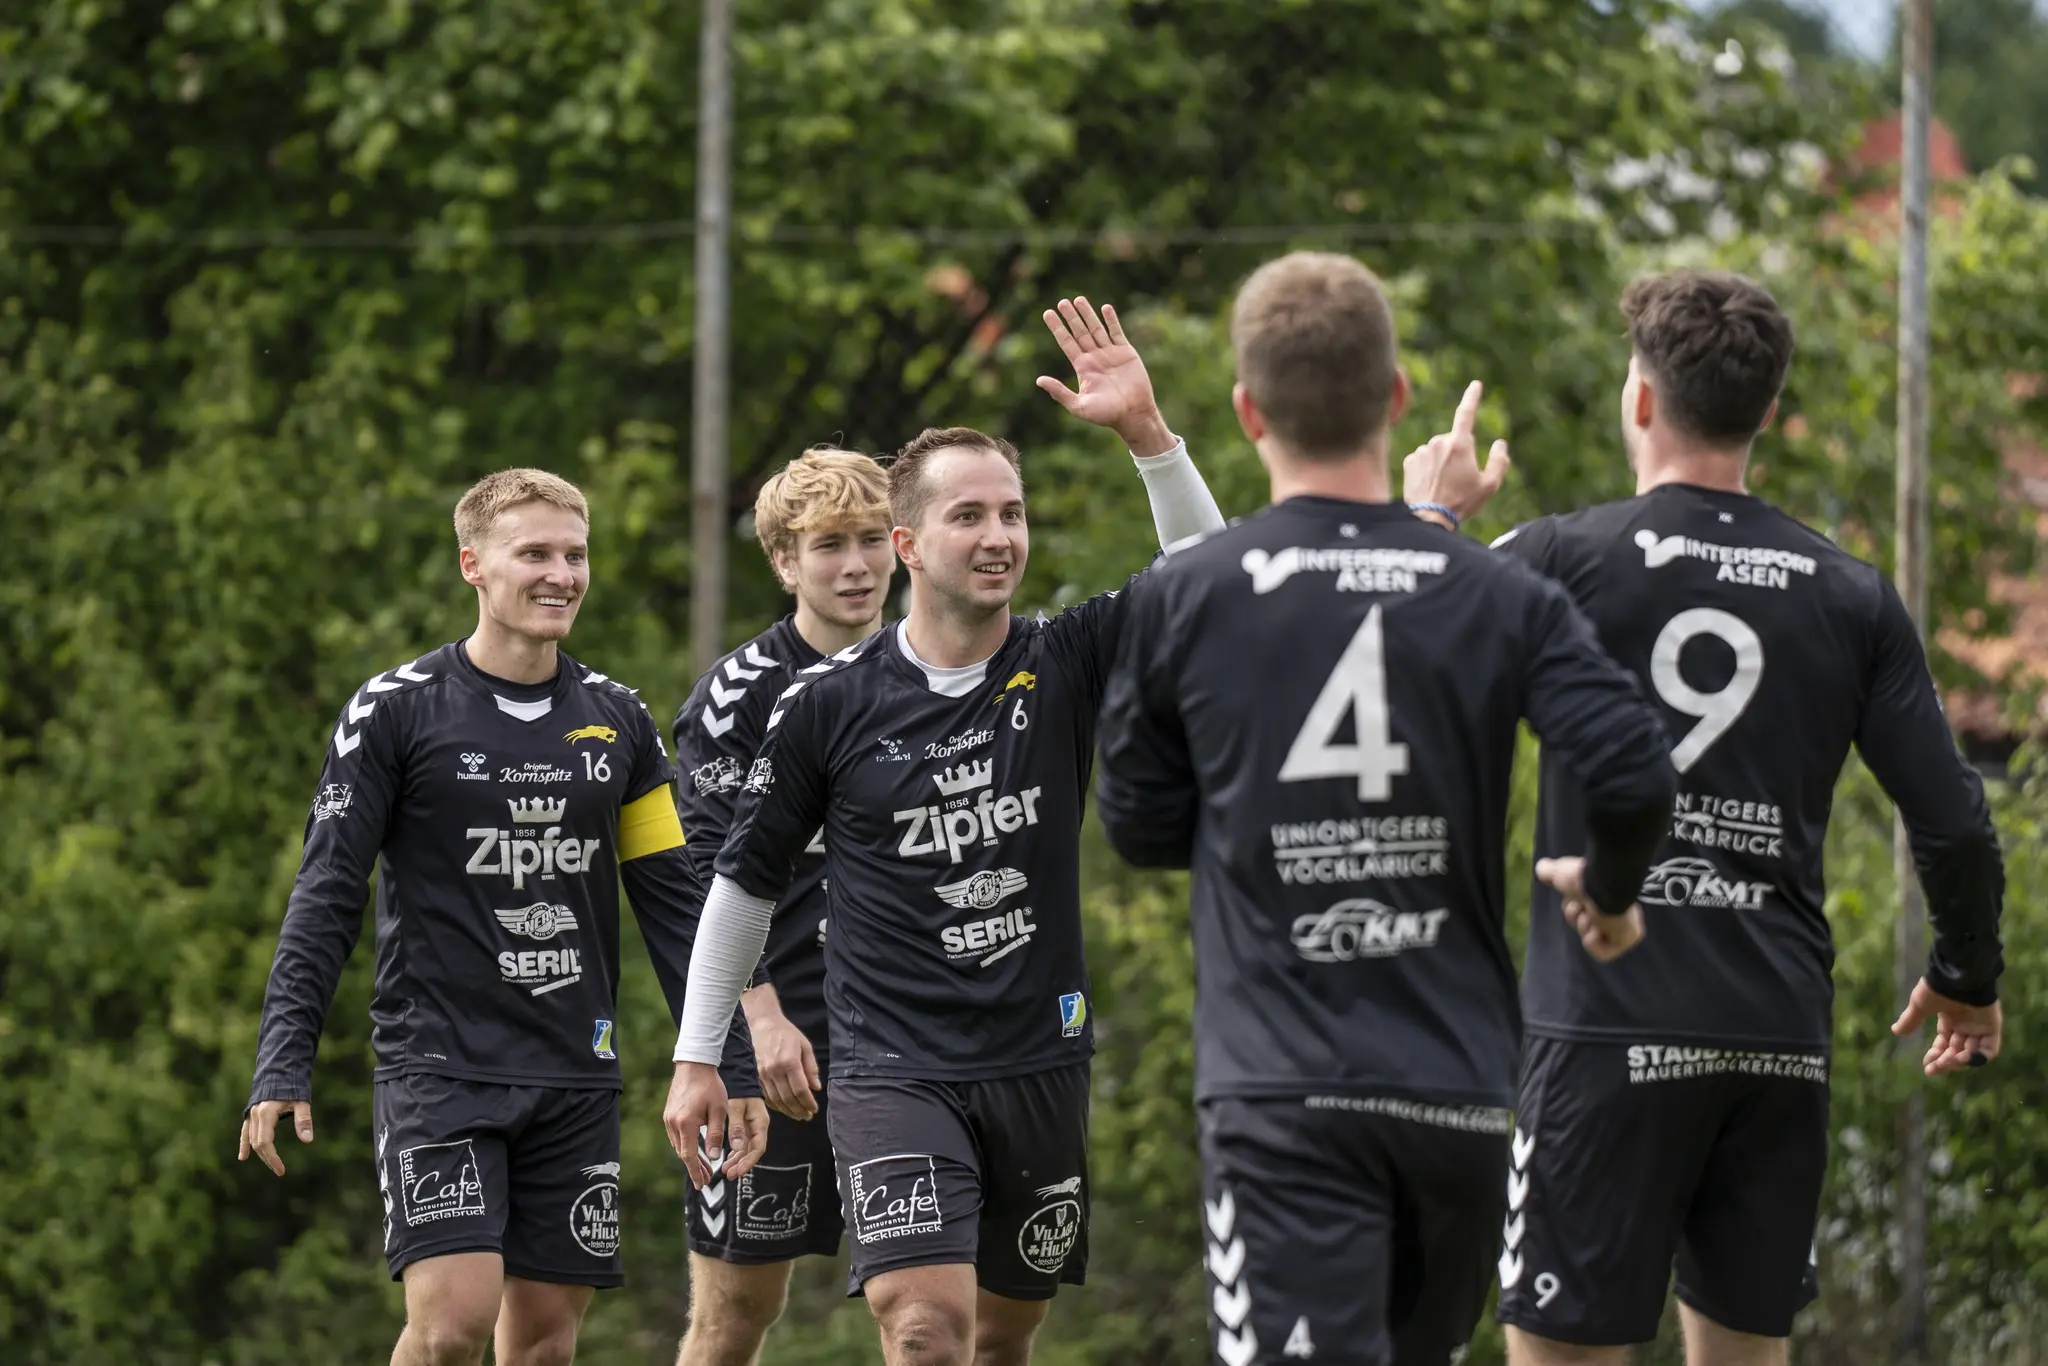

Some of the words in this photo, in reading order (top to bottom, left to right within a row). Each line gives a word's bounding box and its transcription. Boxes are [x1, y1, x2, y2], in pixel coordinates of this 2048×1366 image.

[1686, 537, 1818, 577] INTERSPORT
[1336, 569, 1418, 593] ASEN
[1716, 563, 1789, 591] ASEN
[1278, 601, 1411, 802] 4
[1650, 606, 1765, 774] 9
[1011, 698, 1029, 731] 6
[457, 771, 490, 781] hummel
[499, 767, 573, 785] Kornspitz
[524, 762, 552, 773] Original
[581, 751, 612, 783] 16
[945, 797, 970, 811] 1858
[1700, 794, 1783, 826] TIGERS
[514, 828, 536, 838] 1858
[893, 785, 1042, 865] Zipfer
[465, 826, 601, 891] Zipfer
[958, 867, 1008, 907] ENERGY
[516, 904, 564, 934] ENERGY
[403, 1151, 418, 1187] stadt
[412, 1164, 479, 1209] Cafe
[741, 1172, 756, 1200] tadt
[853, 1167, 866, 1204] stadt
[862, 1177, 935, 1226] Cafe
[412, 1200, 458, 1214] restaurante
[581, 1204, 619, 1223] VILLAG
[863, 1217, 907, 1231] restaurante
[1534, 1271, 1562, 1311] 9
[1282, 1314, 1316, 1360] 4
